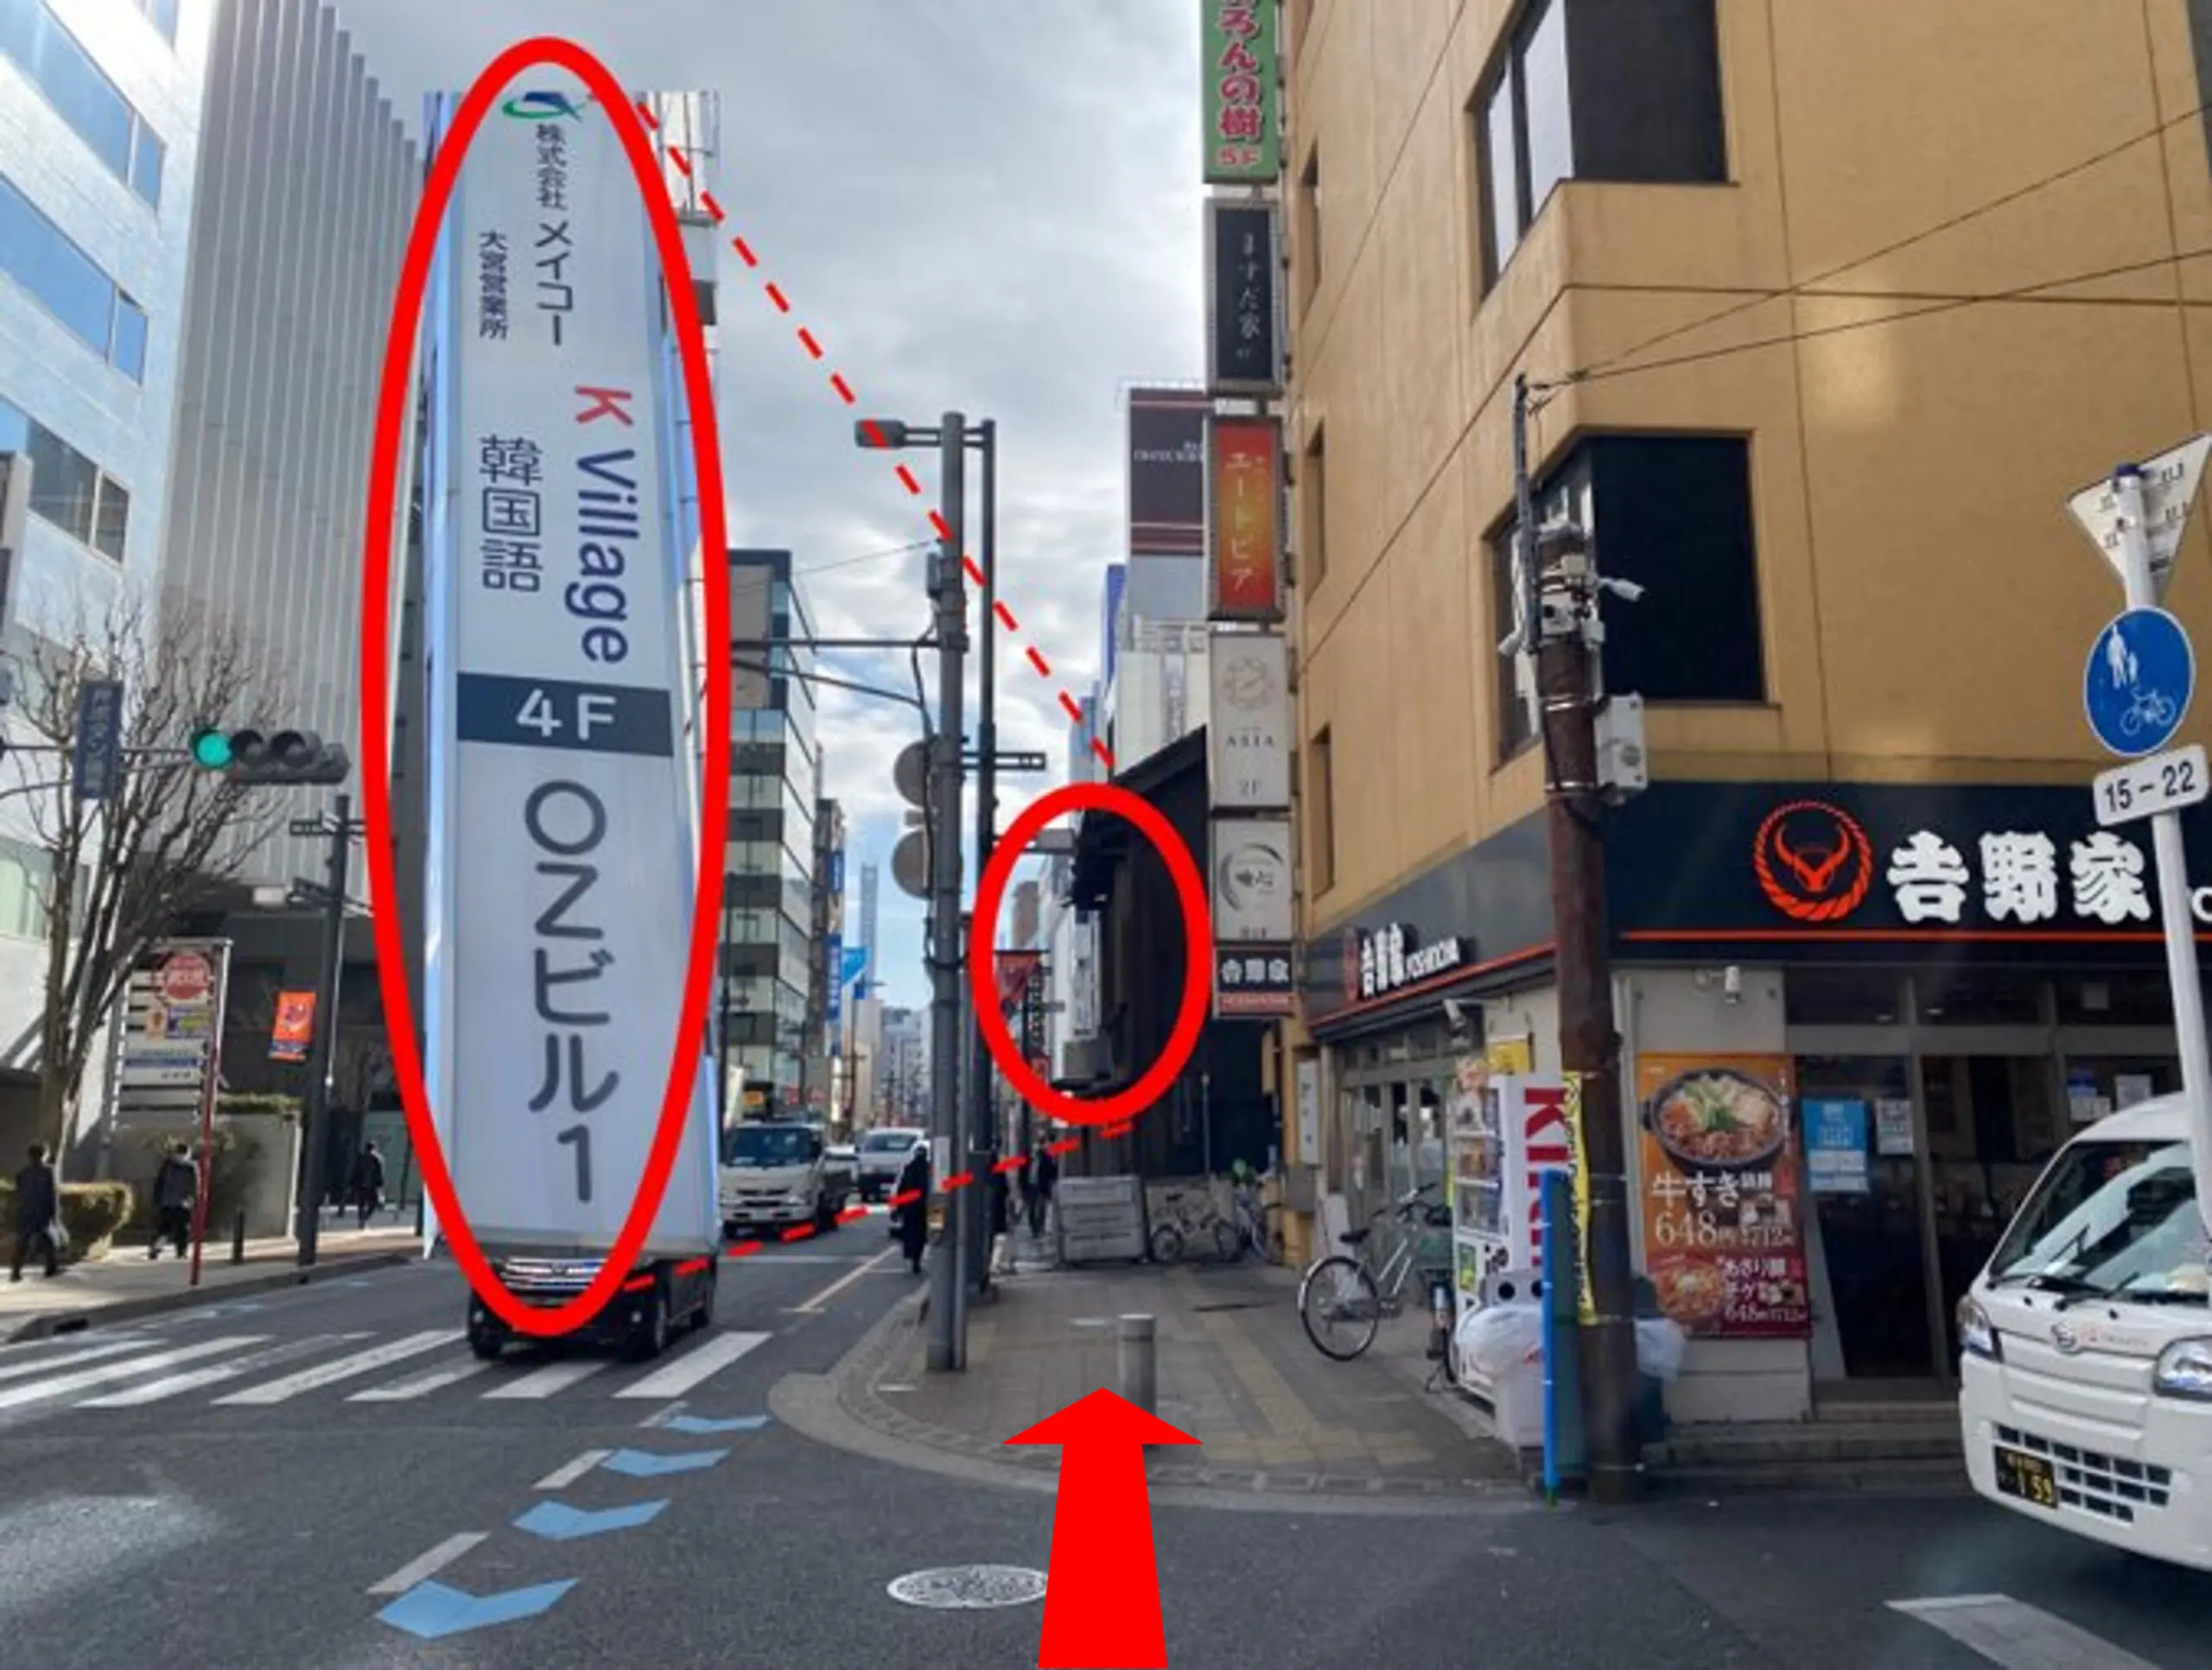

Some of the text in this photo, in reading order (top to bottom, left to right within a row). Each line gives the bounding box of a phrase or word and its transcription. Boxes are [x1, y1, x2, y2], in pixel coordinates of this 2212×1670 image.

[1217, 0, 1262, 138] ろんの樹
[479, 435, 543, 594] 韓国語
[563, 385, 639, 664] K Village
[516, 689, 619, 740] 4F
[1885, 830, 2152, 924] 吉野家
